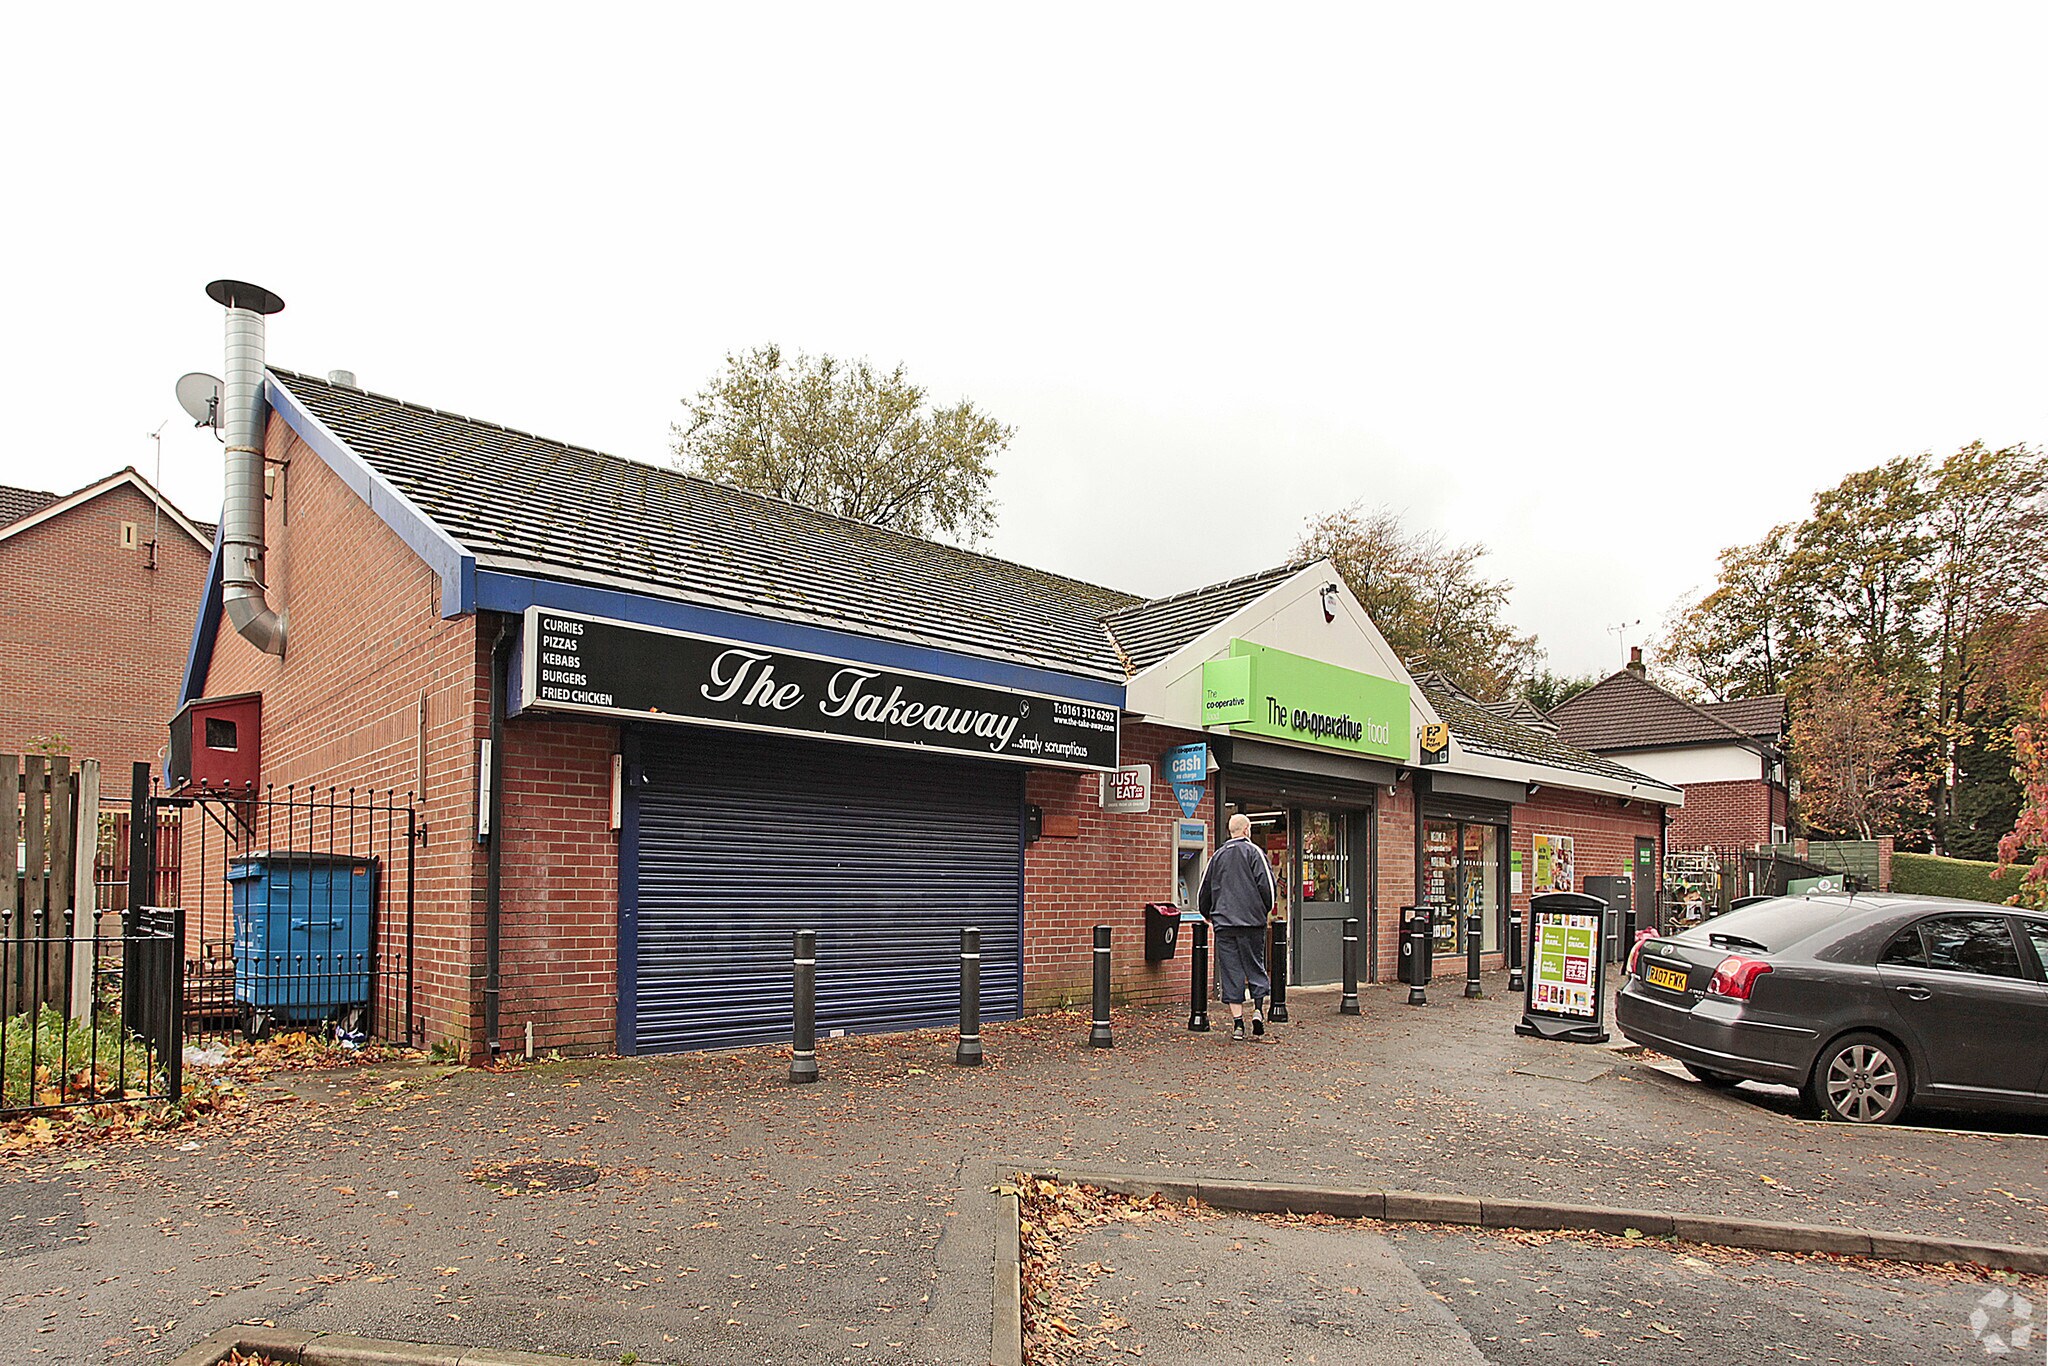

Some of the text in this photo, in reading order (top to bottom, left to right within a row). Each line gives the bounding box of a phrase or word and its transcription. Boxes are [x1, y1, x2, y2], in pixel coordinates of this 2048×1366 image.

[543, 618, 584, 636] CURRIES
[543, 635, 577, 651] PIZZAS
[543, 652, 580, 669] KEBABS
[542, 669, 587, 686] BURGERS
[542, 686, 613, 706] FRIED CHICKEN
[700, 649, 1019, 752] The Takeaway
[1062, 704, 1080, 717] 0161
[1082, 707, 1096, 720] 312
[1096, 710, 1114, 722] 6292
[1266, 696, 1287, 727] The
[1366, 717, 1389, 745] food
[1053, 716, 1115, 732] www.the-take-away.com
[1044, 737, 1088, 759] scrumptious
[1172, 754, 1201, 773] cash
[1110, 772, 1137, 786] JUST
[1116, 786, 1136, 799] EAT
[1179, 787, 1198, 801] cash
[1650, 967, 1668, 983] RA07
